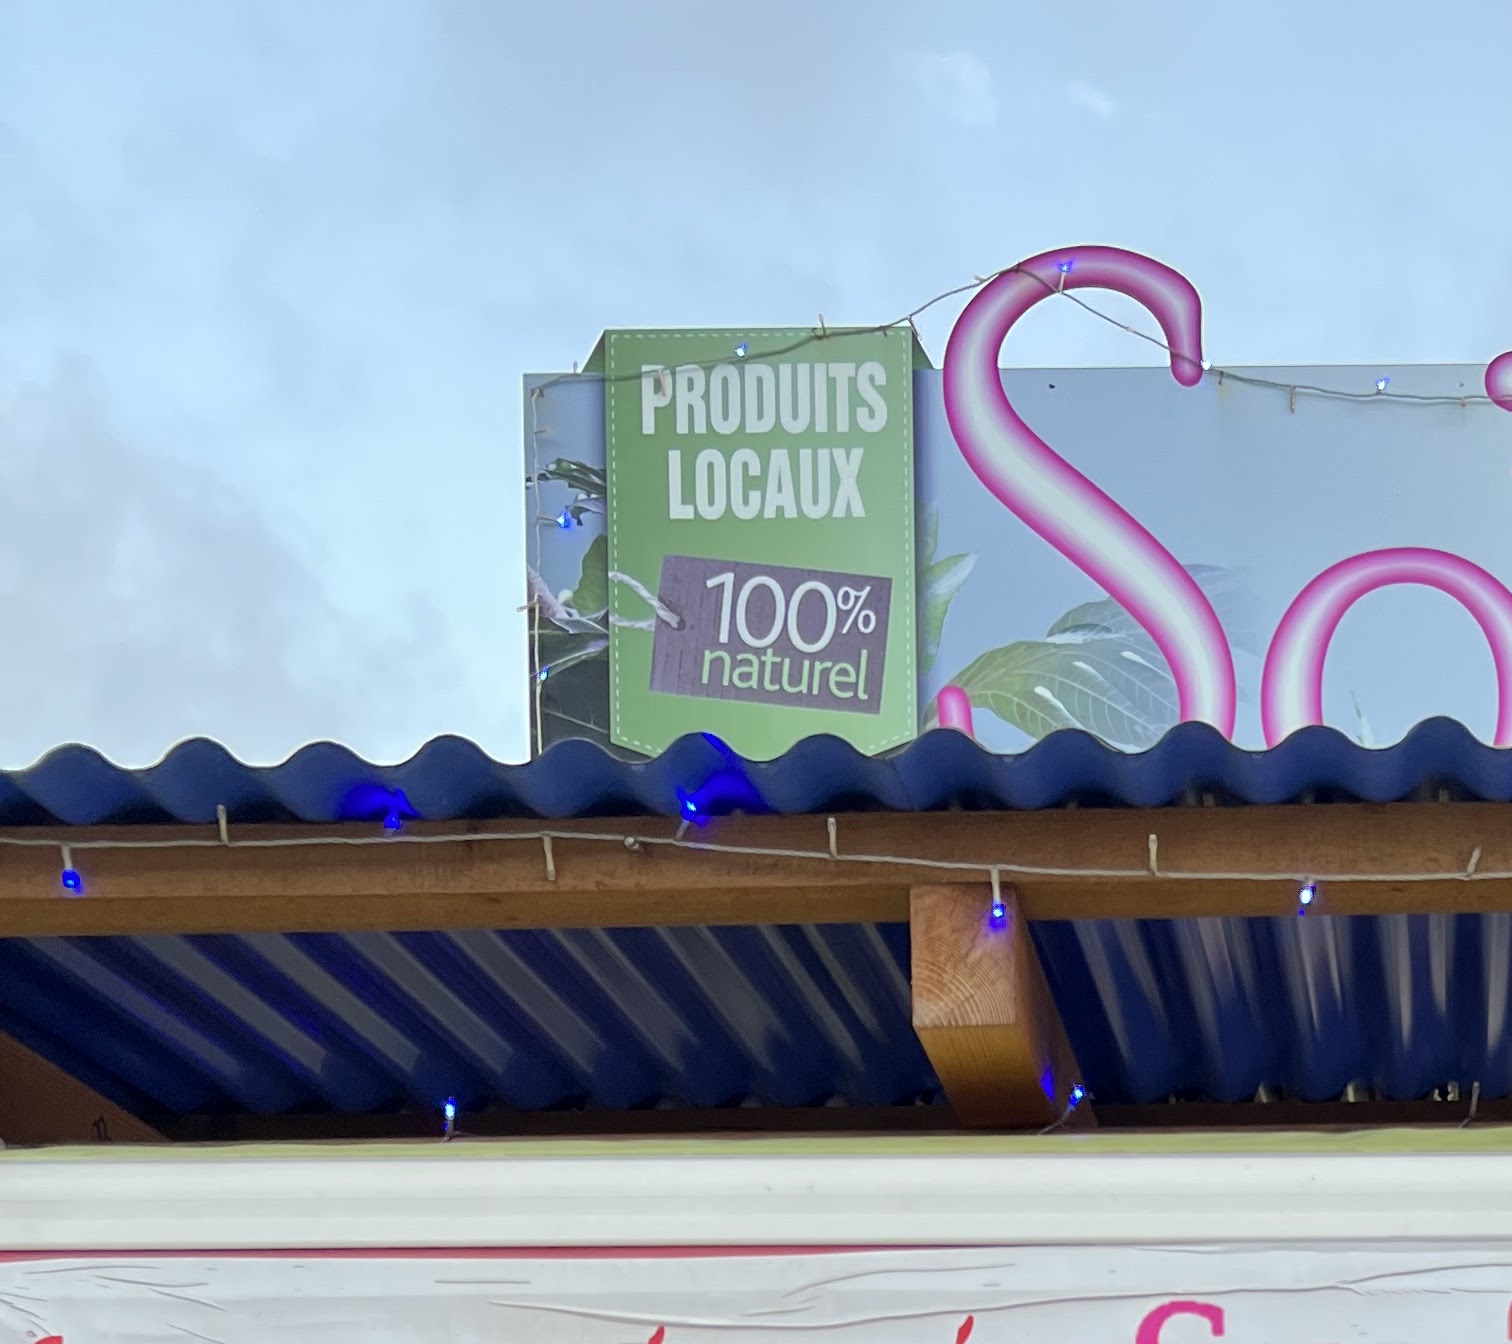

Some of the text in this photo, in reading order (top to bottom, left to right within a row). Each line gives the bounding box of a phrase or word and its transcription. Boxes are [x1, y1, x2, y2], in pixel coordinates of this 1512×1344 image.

[625, 362, 887, 435] PRODUITS
[666, 448, 866, 522] LOCAUX
[706, 572, 876, 653] 100%
[701, 645, 869, 700] naturel
